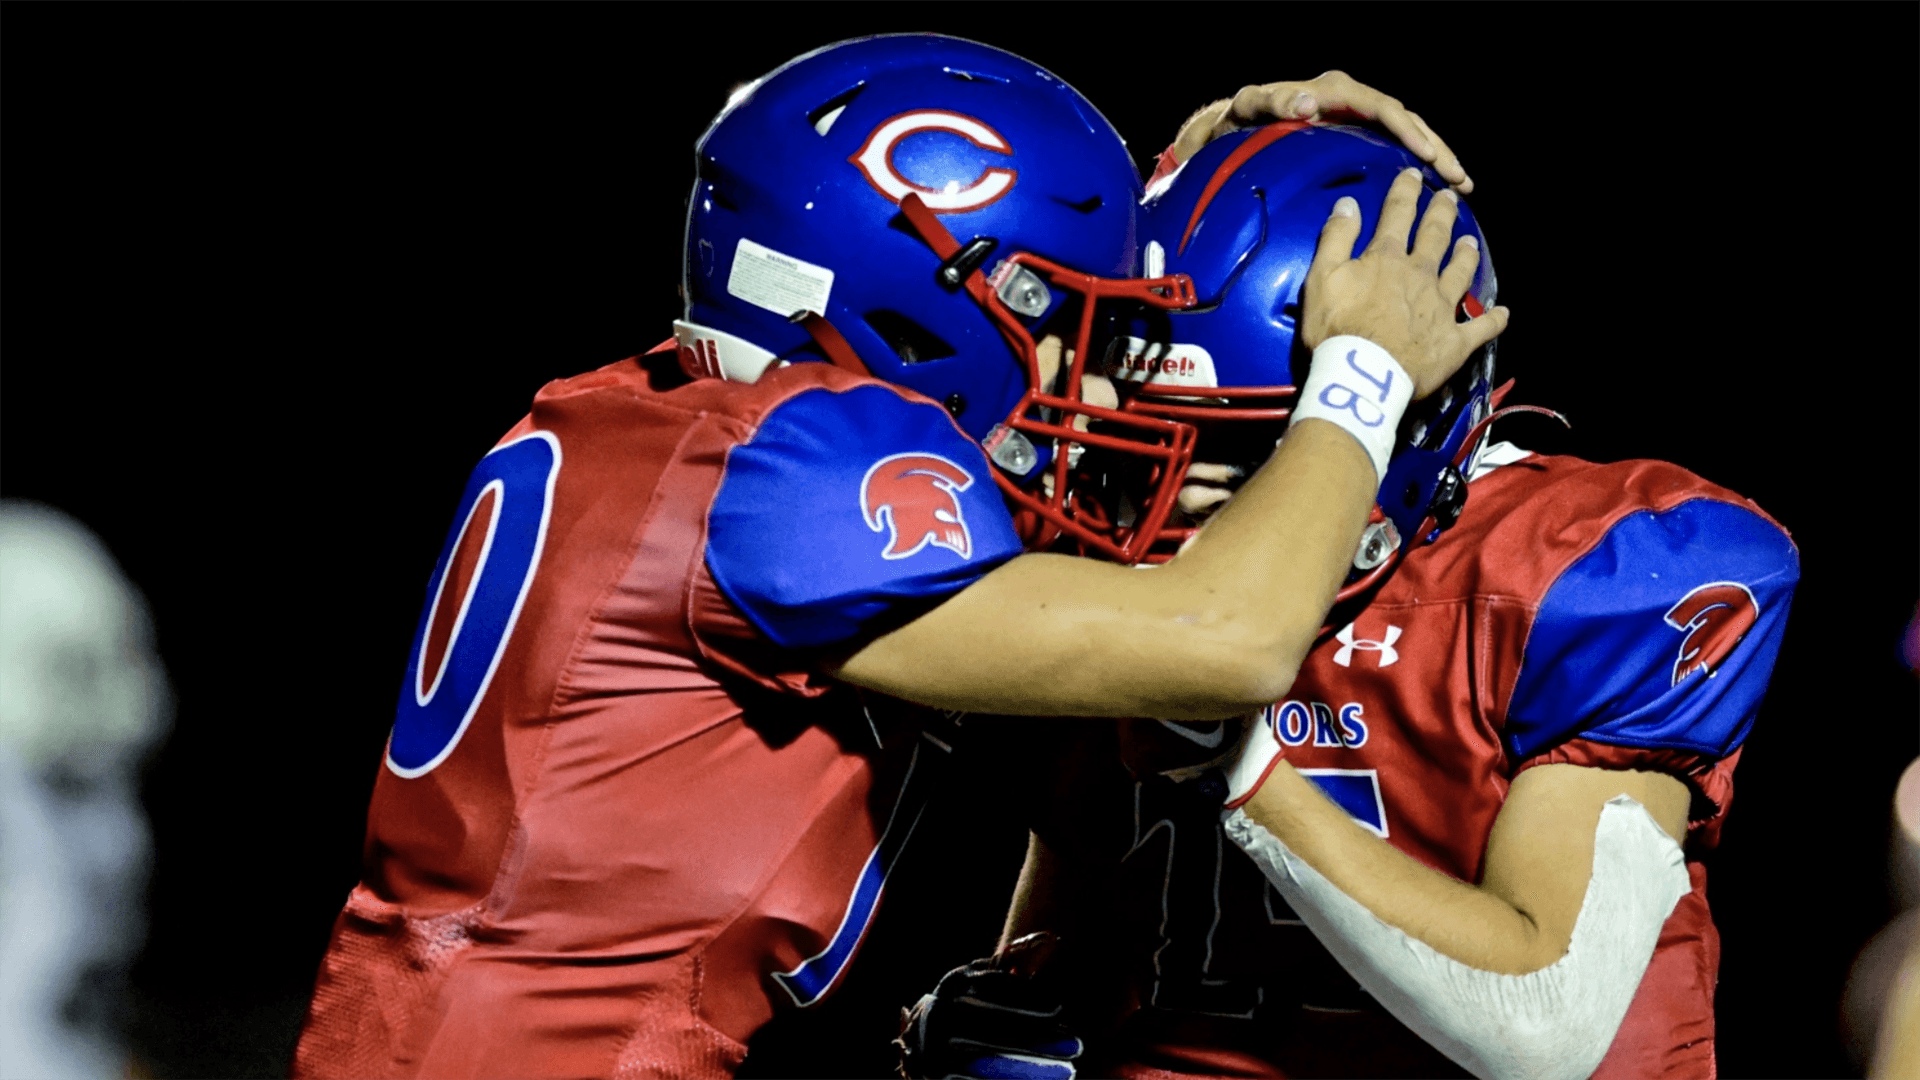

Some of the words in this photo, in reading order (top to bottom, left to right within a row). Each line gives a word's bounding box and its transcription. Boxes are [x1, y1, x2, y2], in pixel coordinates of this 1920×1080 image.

[847, 108, 1018, 214] C
[1318, 349, 1393, 428] JB
[386, 430, 563, 779] 0
